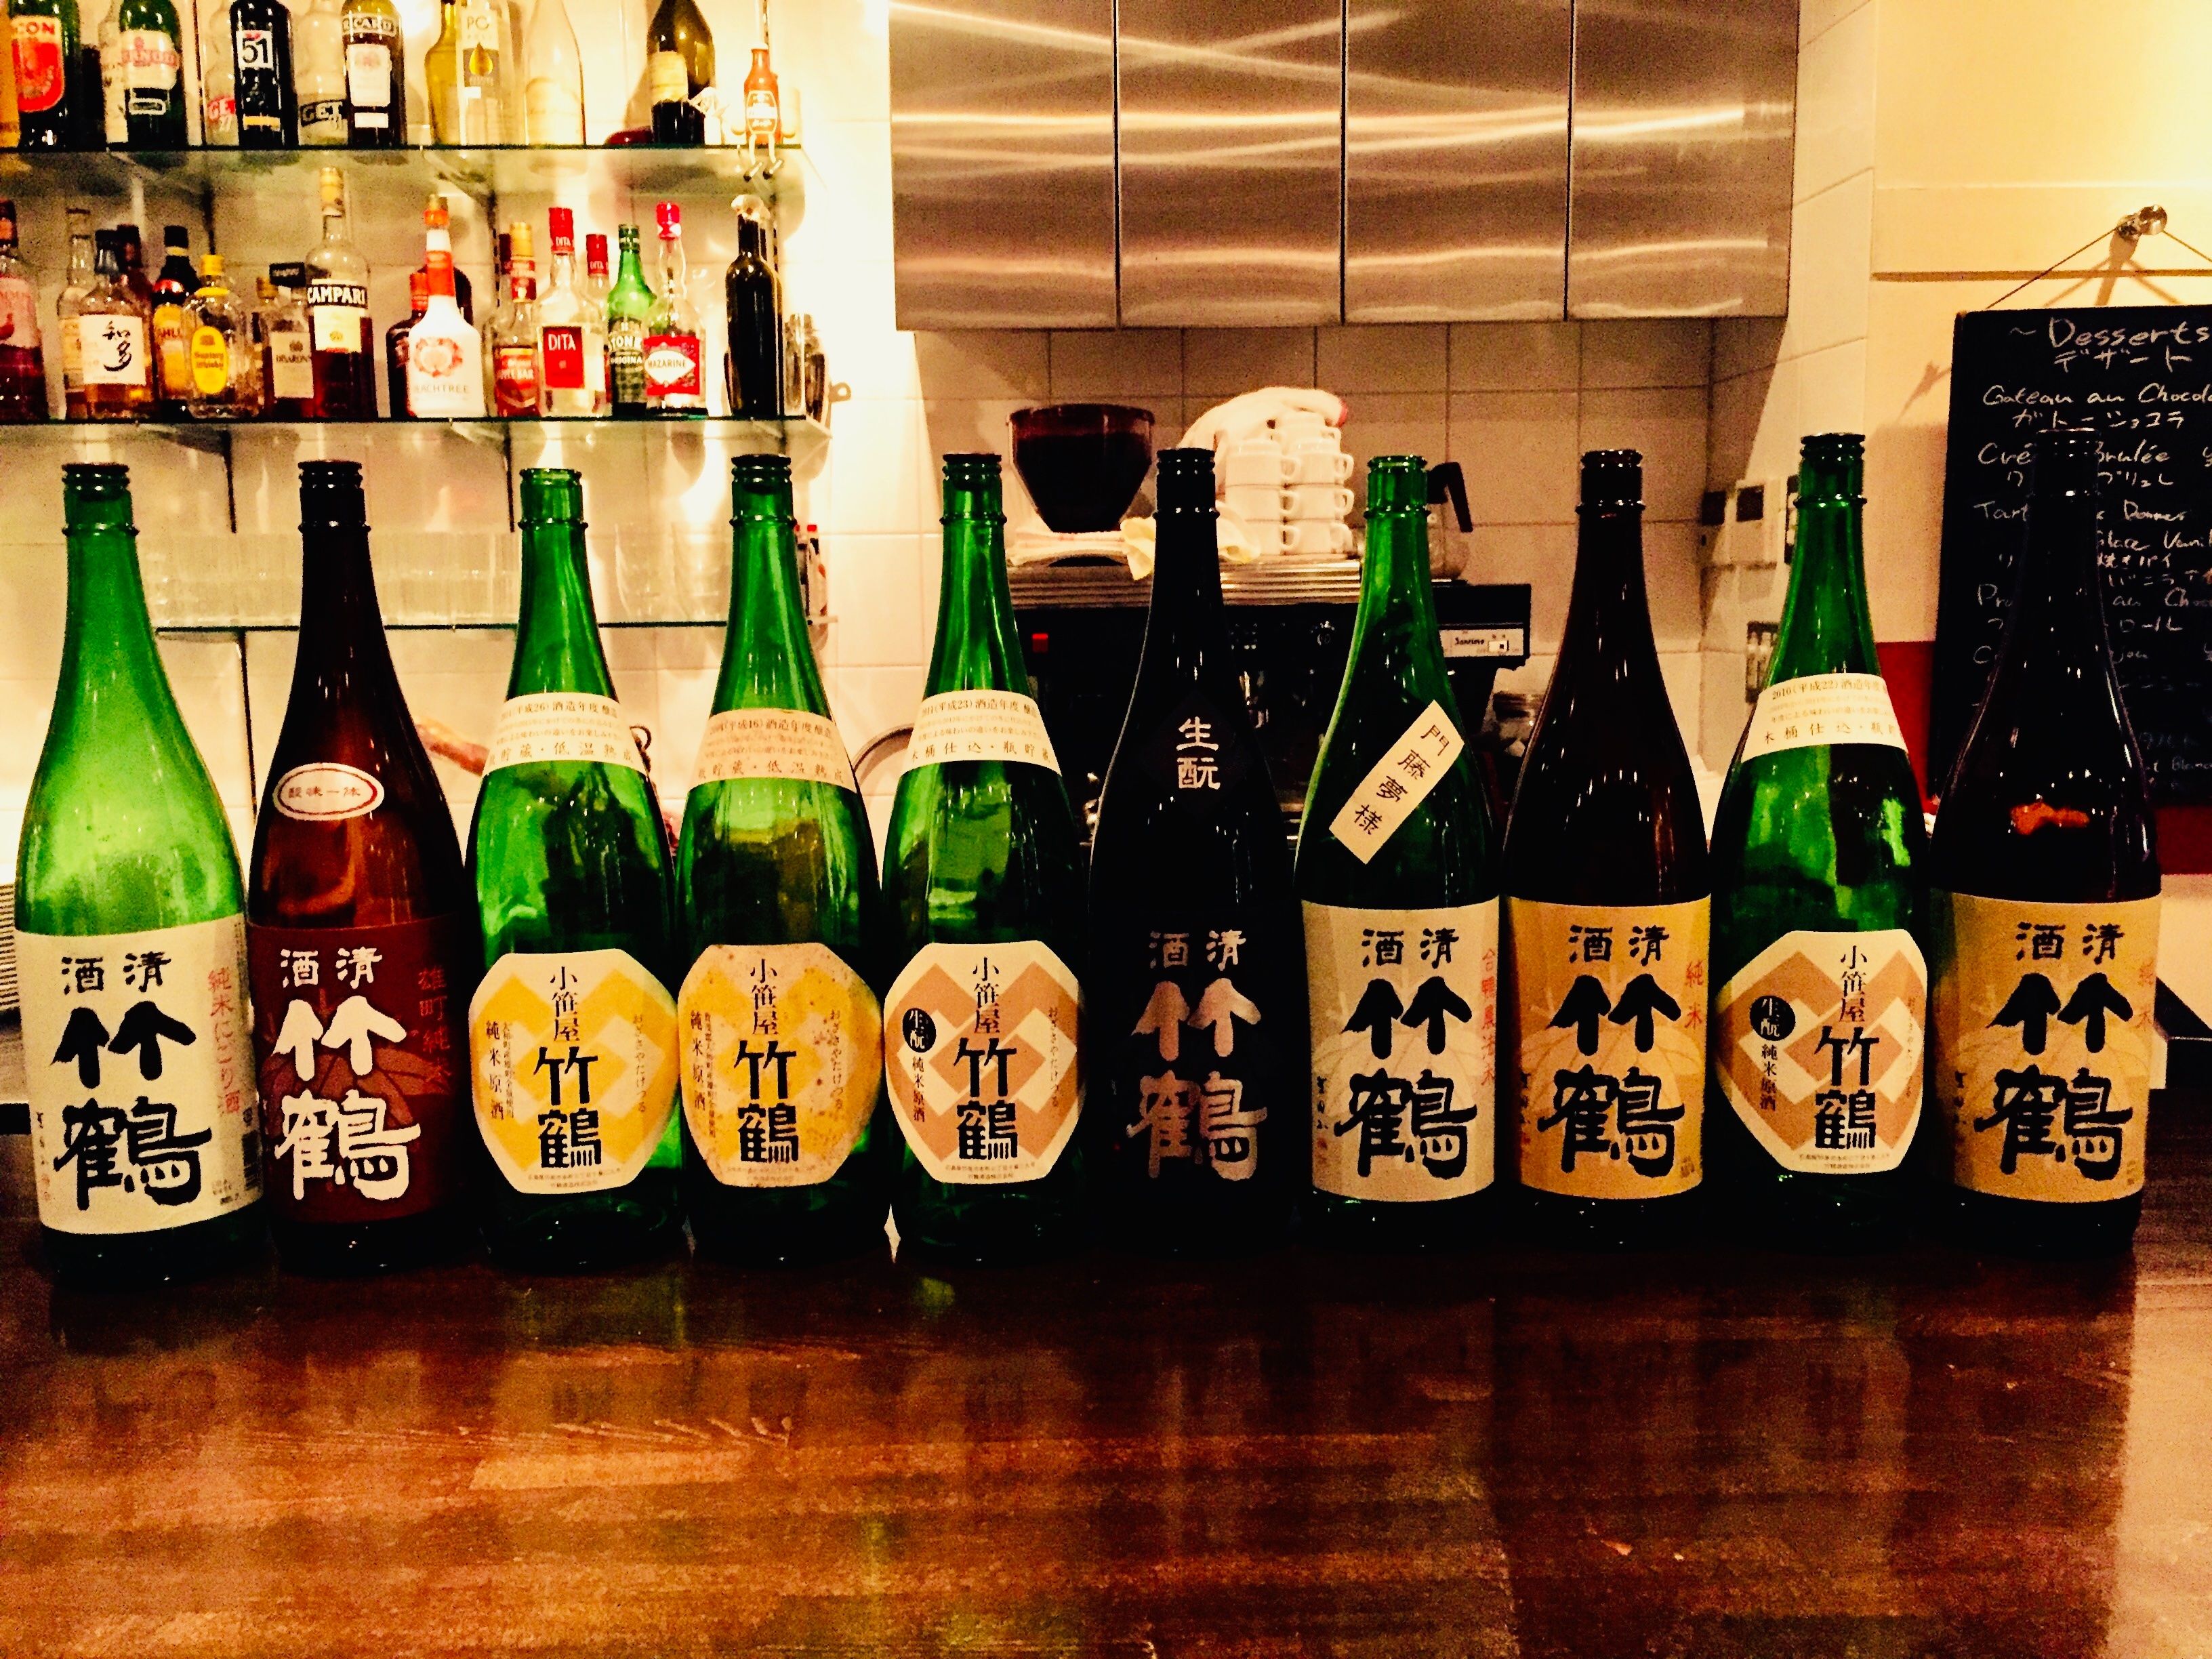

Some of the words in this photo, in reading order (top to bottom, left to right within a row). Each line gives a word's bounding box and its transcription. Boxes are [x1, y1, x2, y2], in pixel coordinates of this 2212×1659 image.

[242, 37, 268, 64] 51
[554, 237, 571, 247] DITA
[307, 286, 365, 305] CAMPARI
[548, 333, 576, 351] DITA
[2047, 316, 2211, 348] Desserts
[1353, 724, 1450, 836] 門藤夢様
[1685, 959, 1704, 1029] 純米
[533, 1046, 602, 1168] 竹鶴
[733, 1040, 800, 1164] 竹鶴
[952, 1037, 1019, 1160] 竹鶴
[1814, 1025, 1880, 1151] 竹鶴
